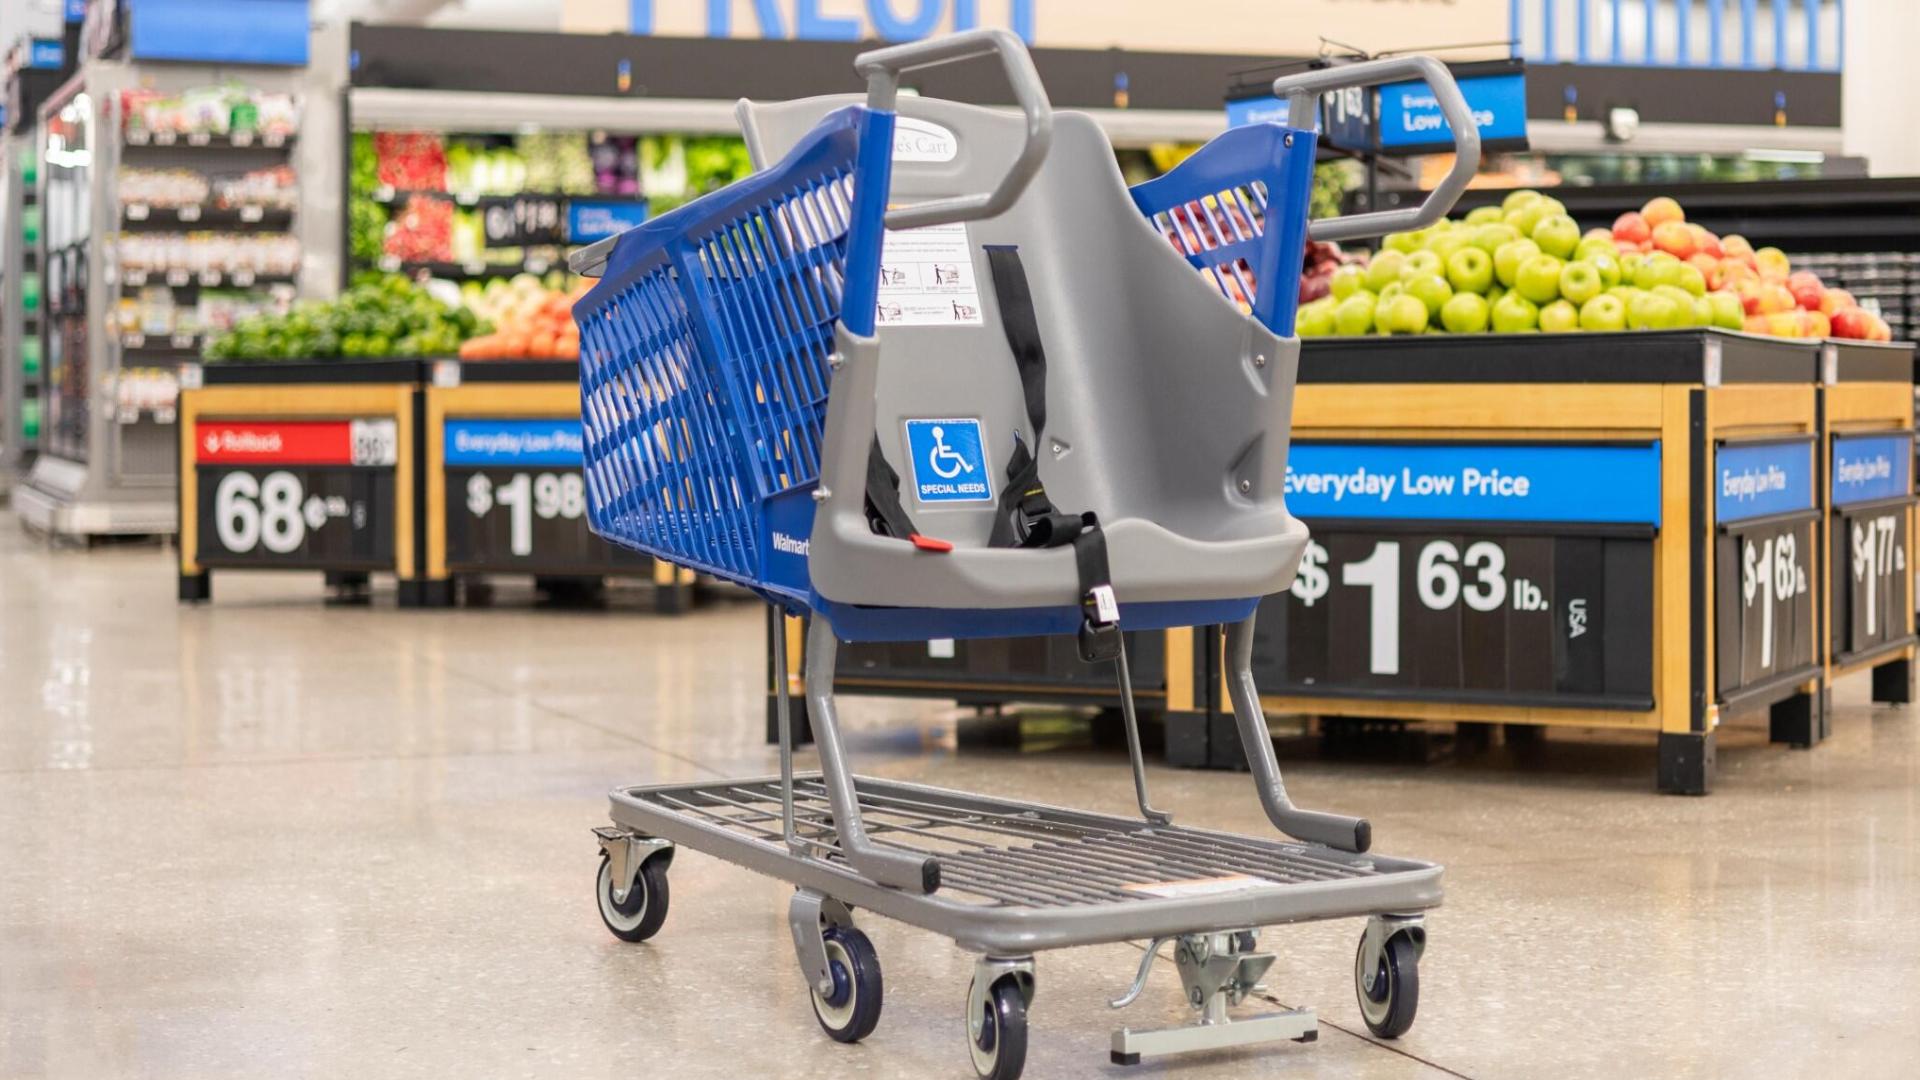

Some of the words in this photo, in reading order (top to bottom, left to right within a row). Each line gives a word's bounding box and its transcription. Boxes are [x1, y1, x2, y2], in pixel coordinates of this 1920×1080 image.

[1403, 110, 1442, 131] Low
[915, 136, 948, 154] Cart
[920, 483, 957, 494] SPECIAL
[958, 483, 986, 493] NEEDS
[1284, 466, 1396, 501] Everyday
[1402, 467, 1455, 496] Low
[1462, 468, 1530, 496] Price
[772, 531, 809, 556] Walmart
[1513, 578, 1549, 611] lb.
[1569, 598, 1588, 639] USA
